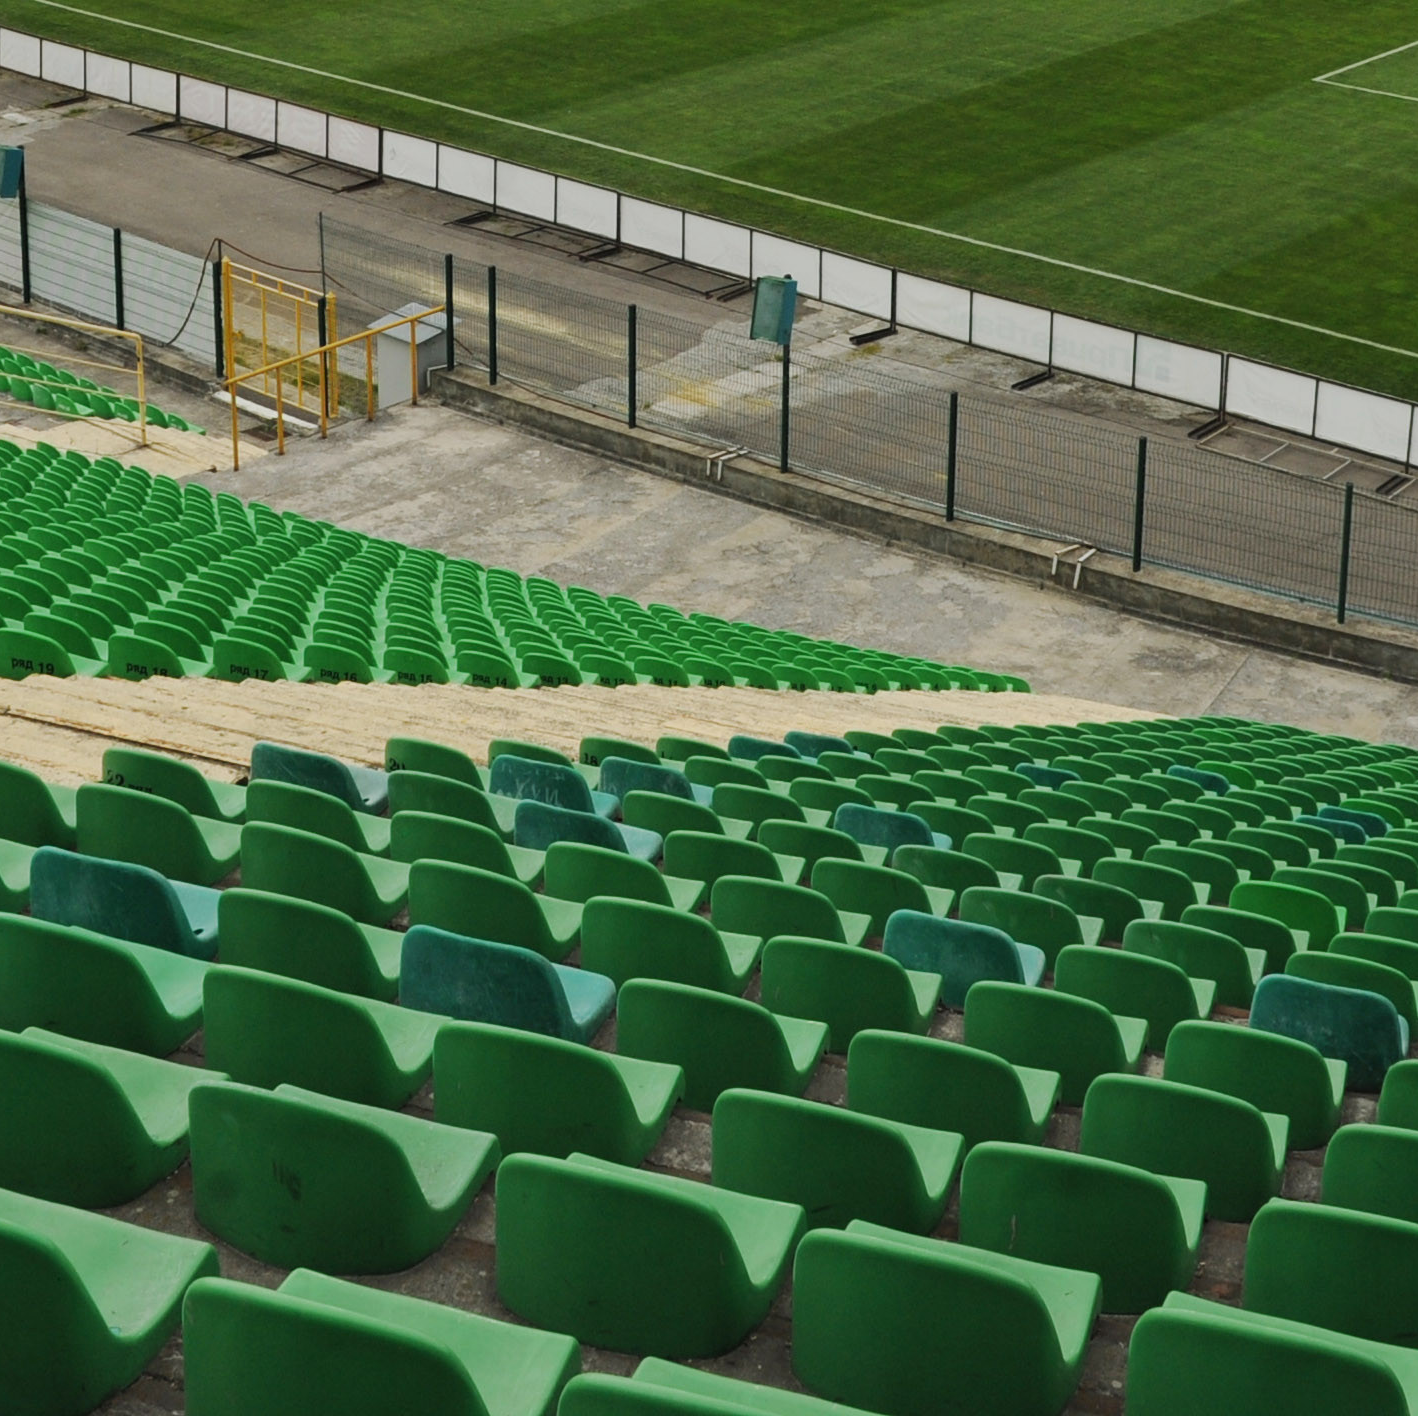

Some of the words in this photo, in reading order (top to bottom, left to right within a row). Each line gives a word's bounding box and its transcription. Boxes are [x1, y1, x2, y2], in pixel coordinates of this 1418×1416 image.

[11, 655, 35, 674] ряд
[37, 660, 55, 676] 19
[126, 661, 149, 678] ряд
[230, 662, 251, 679] ряд
[253, 667, 269, 680] 17
[319, 668, 341, 681] ряд
[344, 671, 357, 682] 16
[397, 670, 418, 683] ряд
